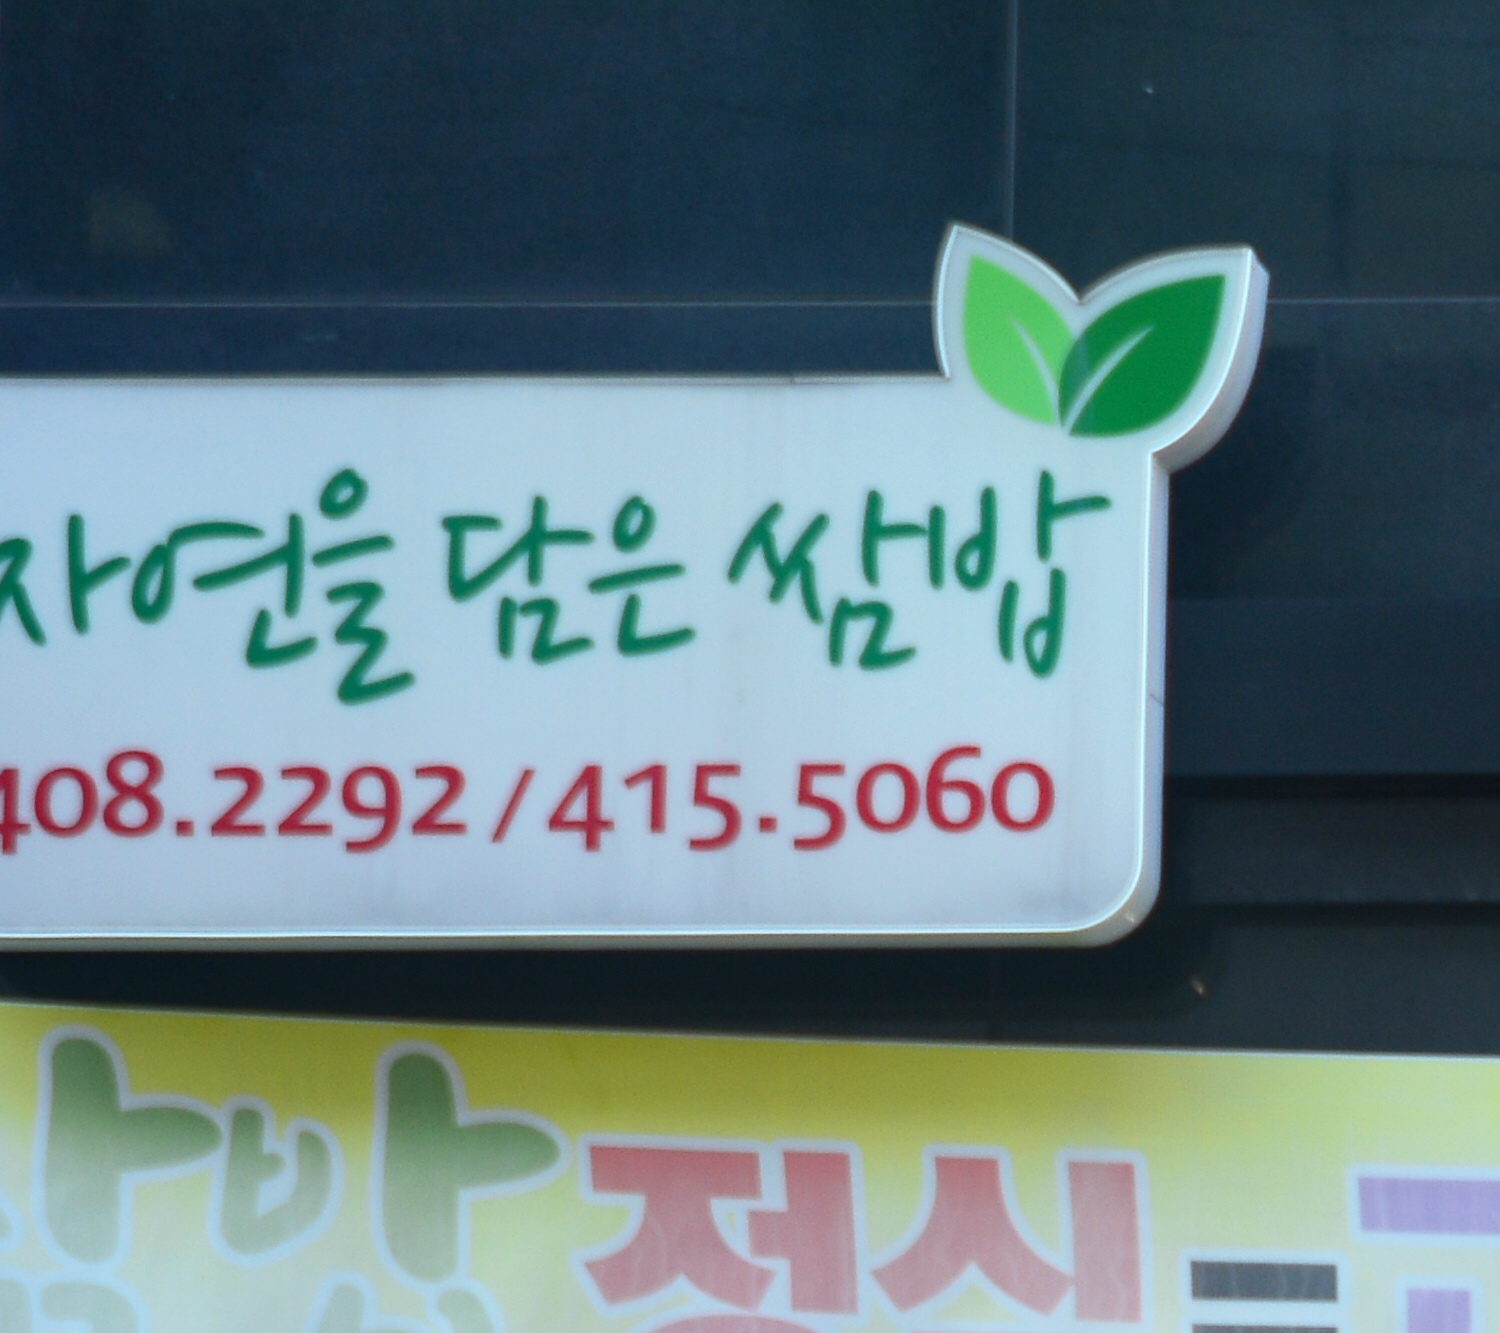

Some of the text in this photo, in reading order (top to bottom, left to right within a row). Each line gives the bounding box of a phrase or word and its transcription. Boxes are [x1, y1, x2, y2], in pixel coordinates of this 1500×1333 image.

[0, 466, 1112, 706] 자연을 담은 쌈밥
